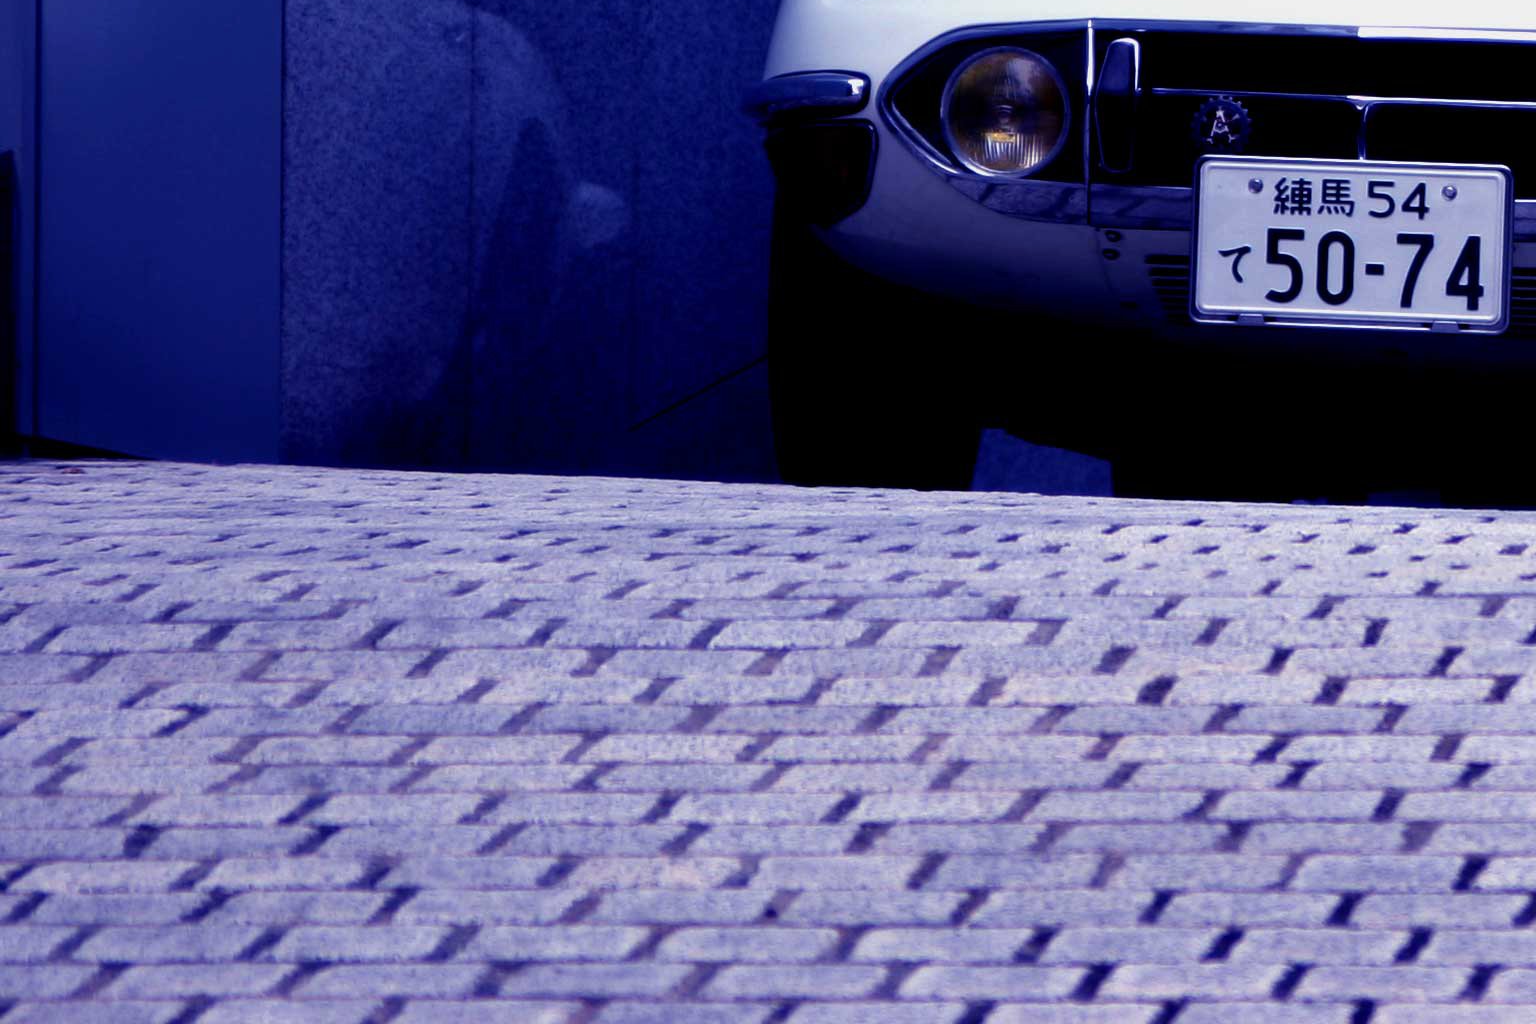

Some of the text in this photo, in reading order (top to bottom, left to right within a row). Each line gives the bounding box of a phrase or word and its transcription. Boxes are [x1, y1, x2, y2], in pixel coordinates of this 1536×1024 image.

[1273, 177, 1430, 221] 練馬 54
[1218, 227, 1484, 312] て 50-74
